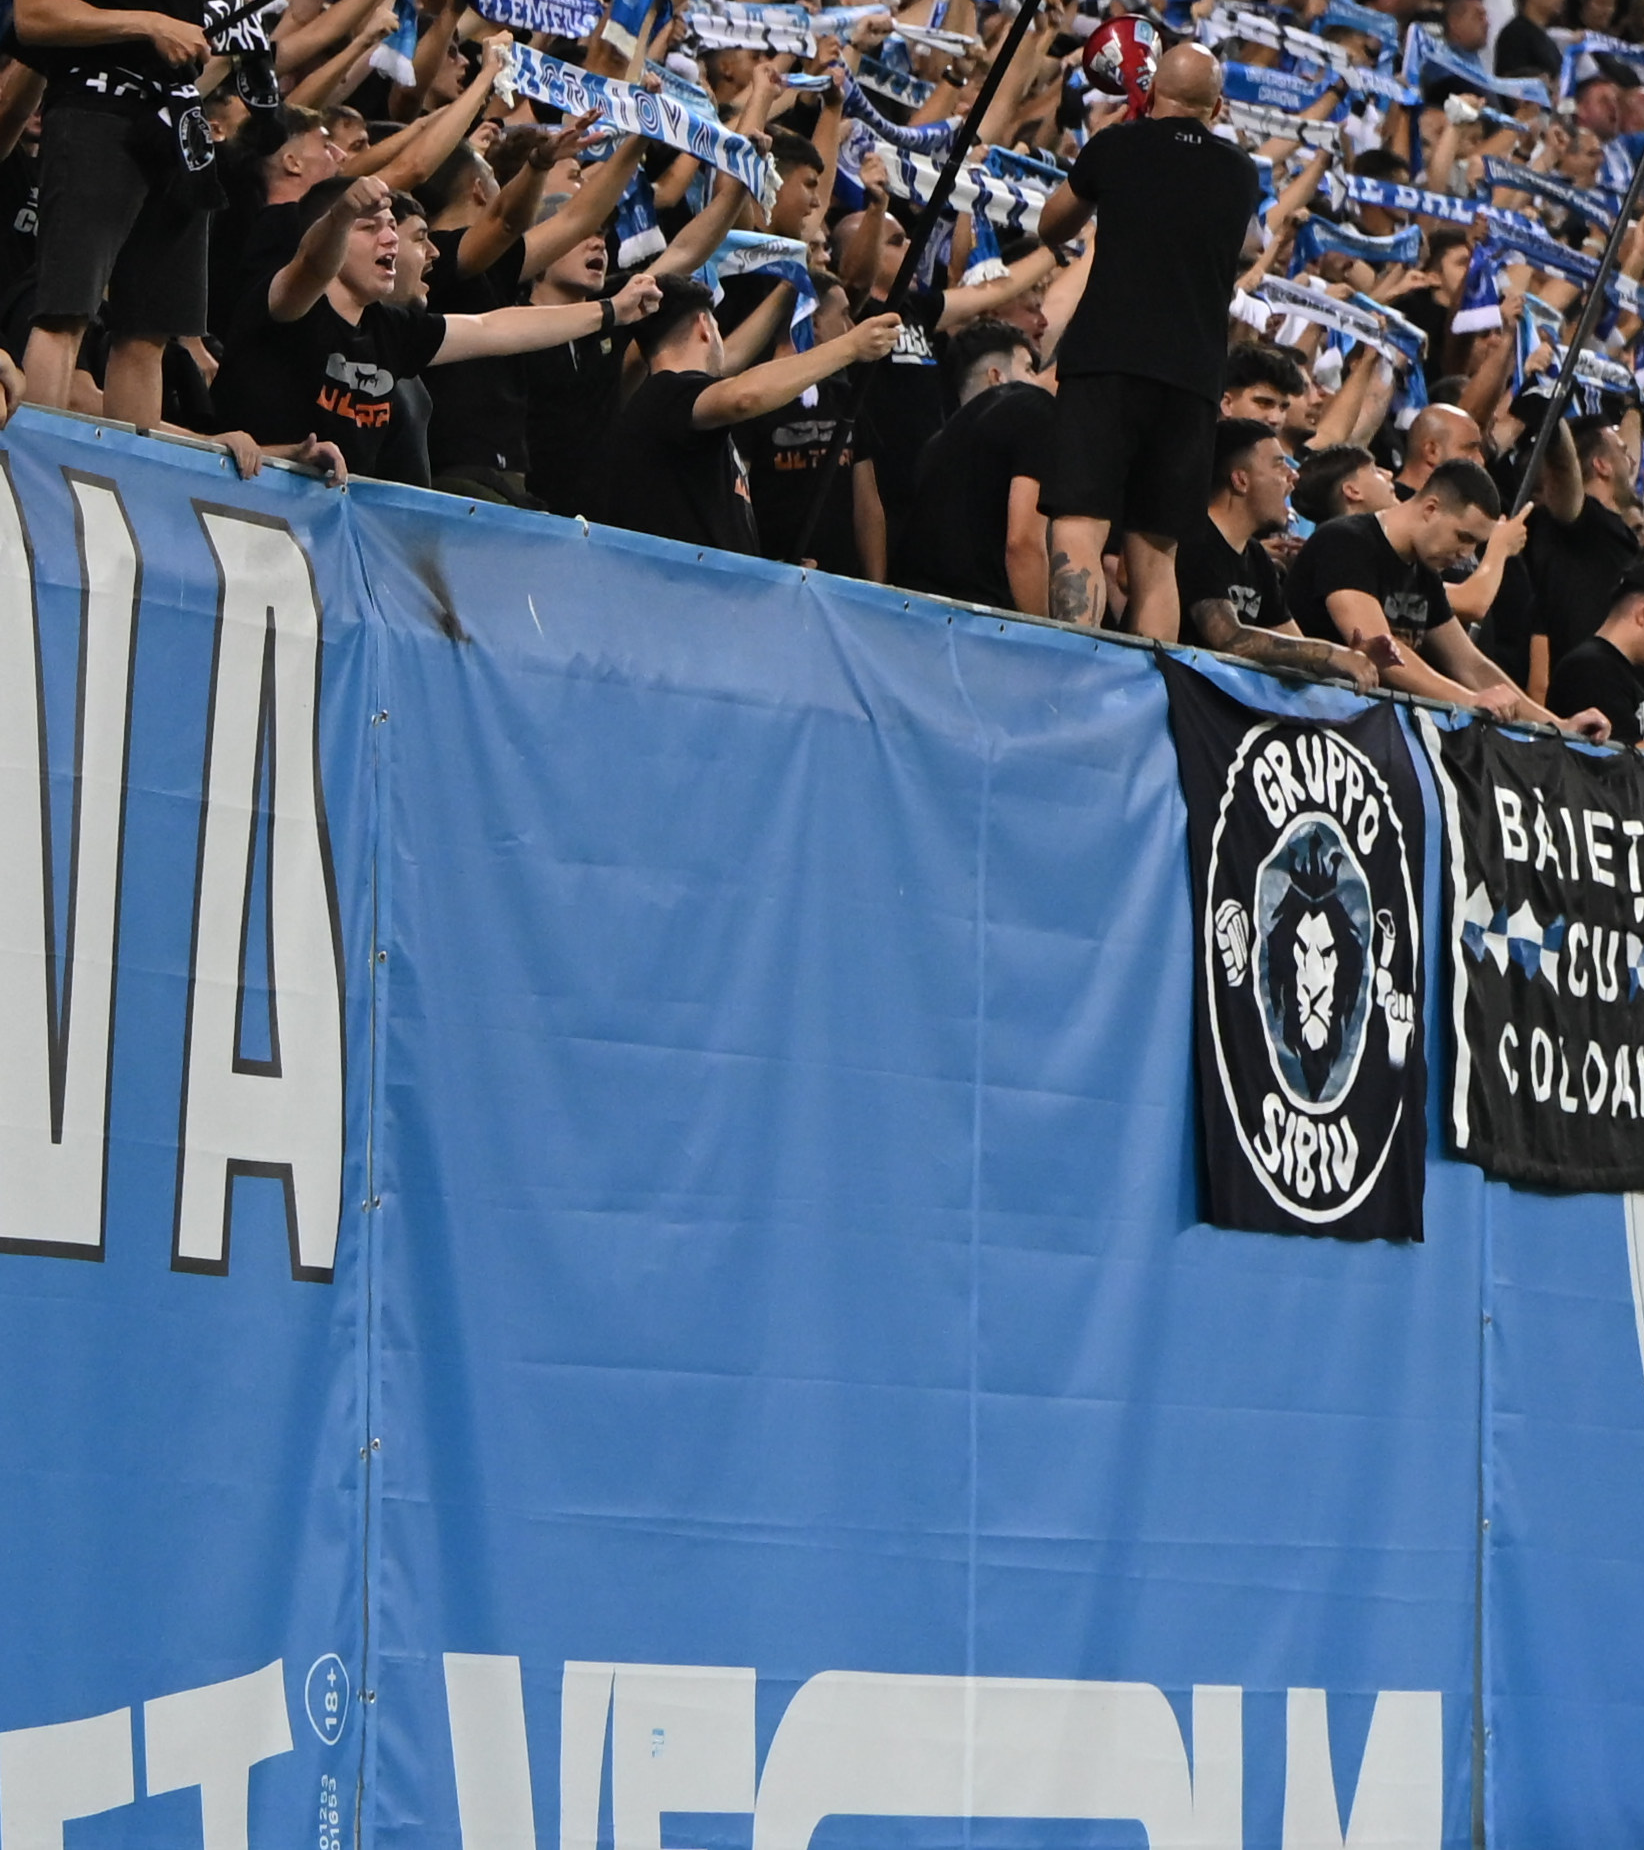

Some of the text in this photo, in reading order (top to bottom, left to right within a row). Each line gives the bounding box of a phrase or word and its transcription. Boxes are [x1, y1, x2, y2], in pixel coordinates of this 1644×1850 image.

[1253, 734, 1381, 856] GRUPPO
[1567, 921, 1620, 1003] CU
[1253, 1092, 1361, 1198] SIBIU
[324, 1666, 339, 1732] 18+
